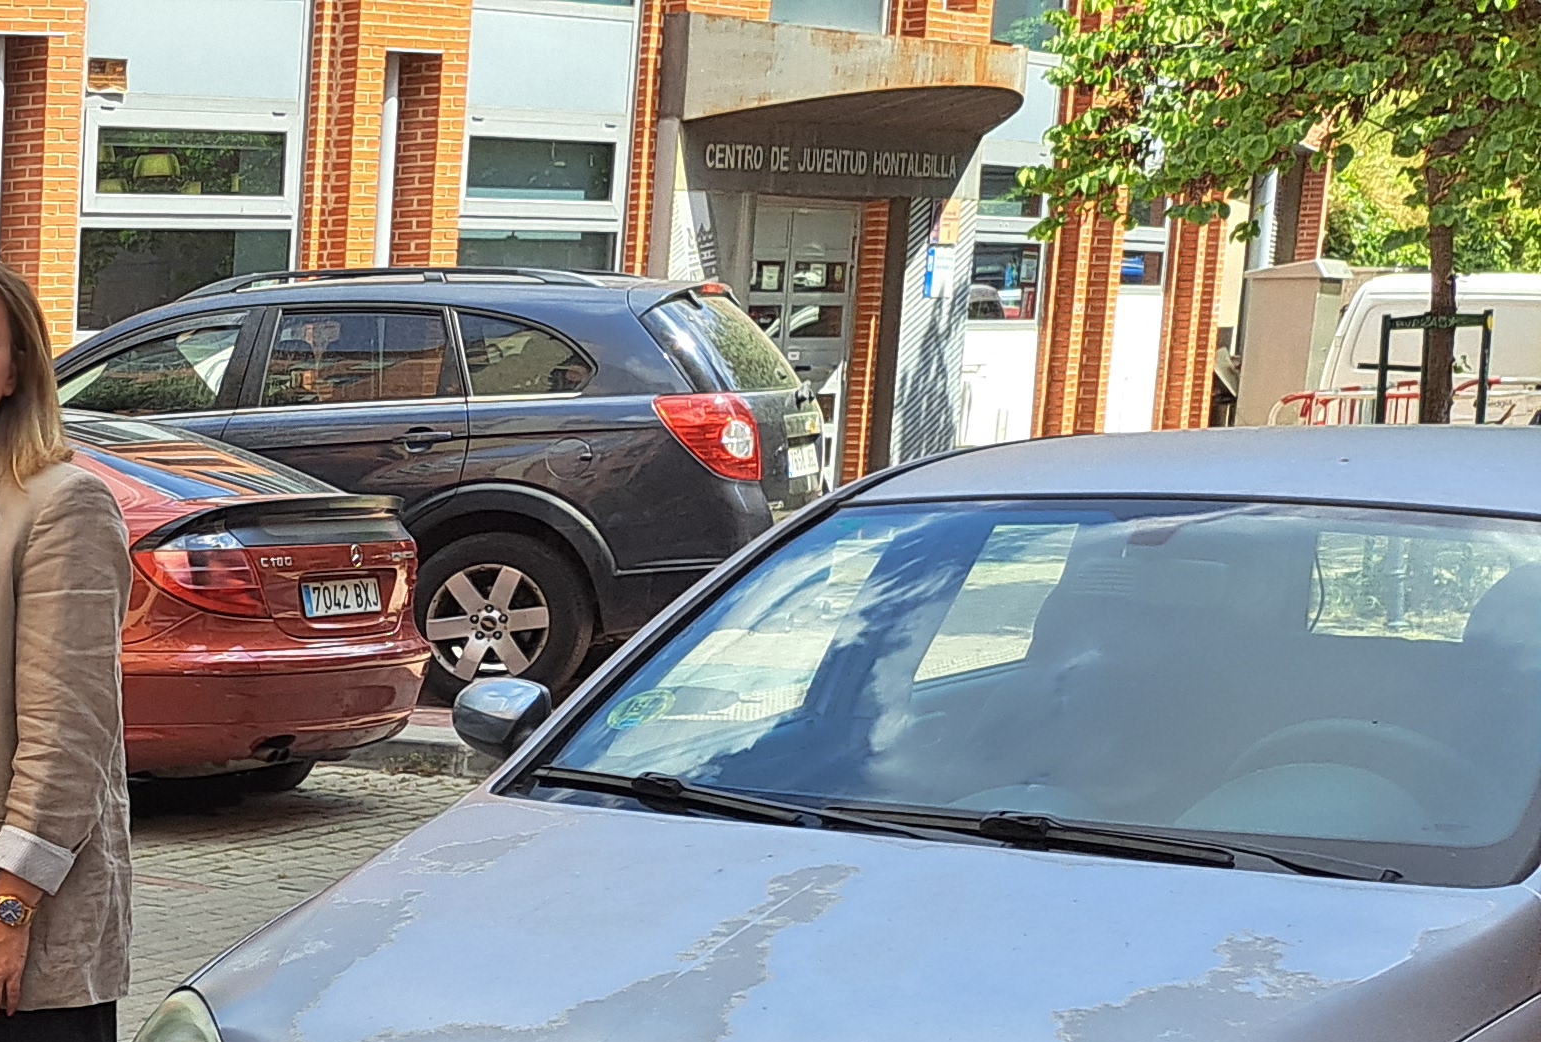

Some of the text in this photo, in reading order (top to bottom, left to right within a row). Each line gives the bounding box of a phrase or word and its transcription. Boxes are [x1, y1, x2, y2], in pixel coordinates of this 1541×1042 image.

[705, 143, 957, 179] CENTRO DE JUVENTUD HONTALBILLA
[312, 580, 379, 613] 7042 BXJ
